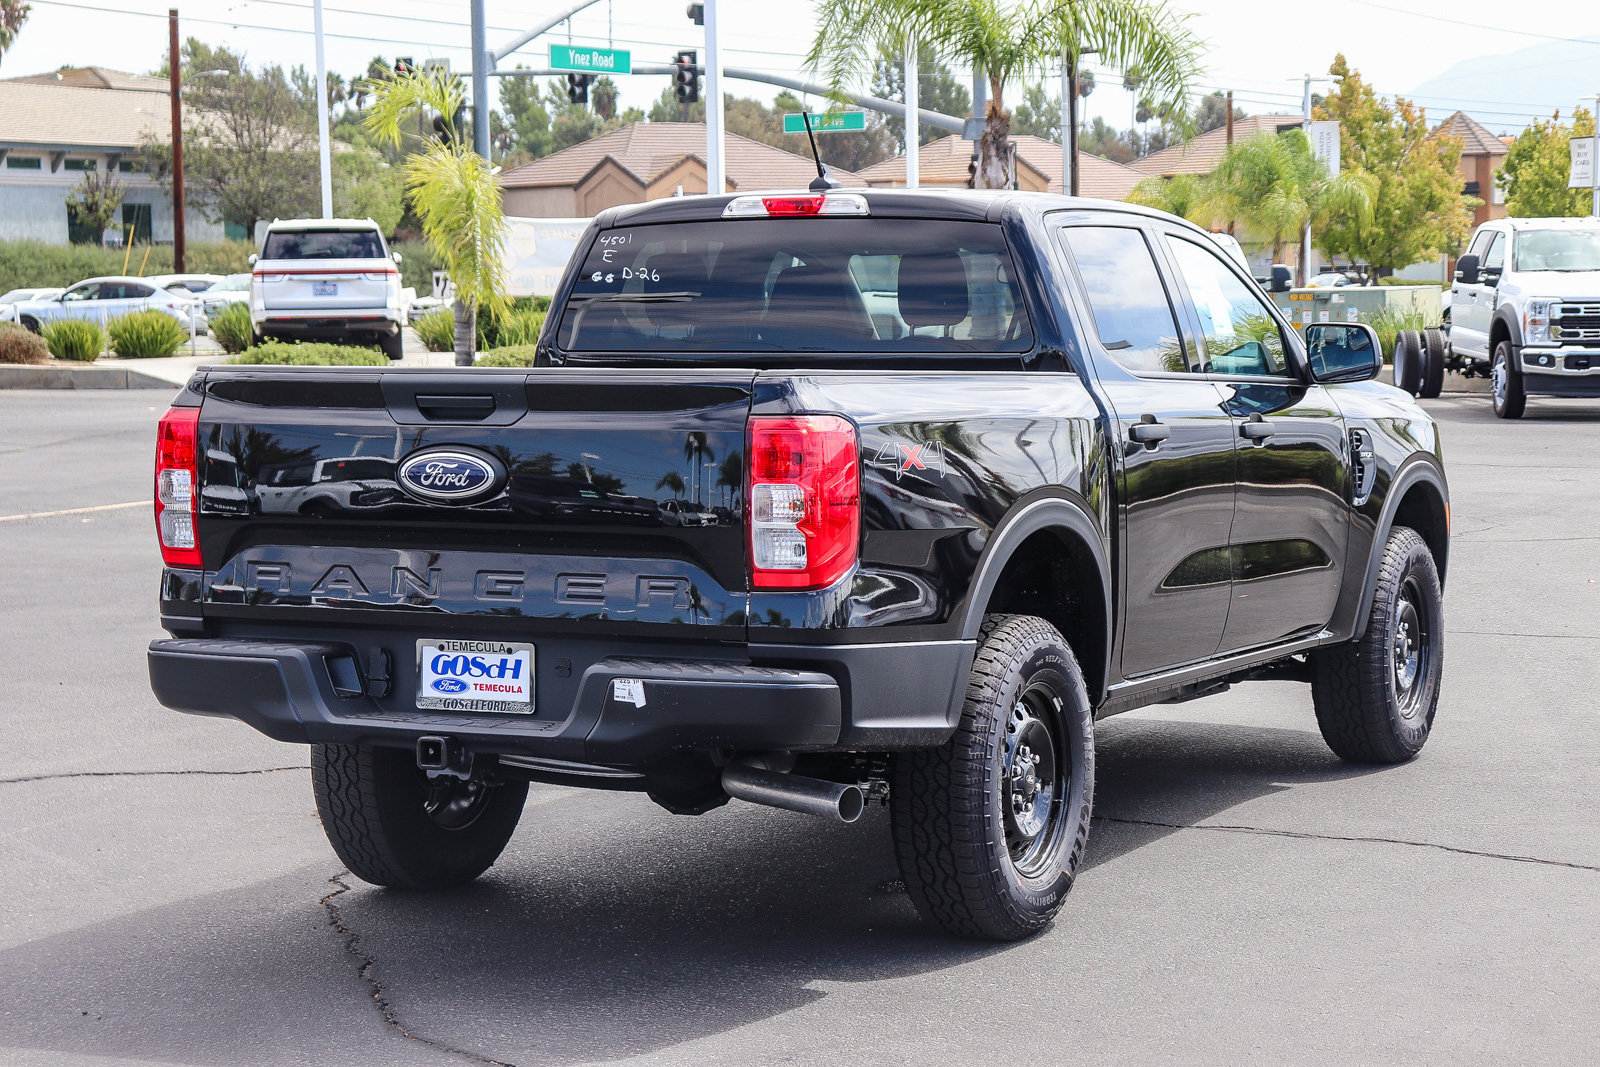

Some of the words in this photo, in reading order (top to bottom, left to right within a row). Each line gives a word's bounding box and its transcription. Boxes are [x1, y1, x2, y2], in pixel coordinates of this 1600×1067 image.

[568, 49, 590, 65] Ynez
[592, 51, 614, 67] Road
[600, 233, 632, 246] 4501
[602, 249, 618, 263] E
[622, 267, 660, 282] D-26
[420, 461, 471, 487] Ford
[246, 560, 692, 609] RANGER
[444, 640, 506, 653] TEMECULA
[438, 679, 461, 692] Ford
[473, 682, 523, 694] TEMECULA
[481, 700, 507, 712] FORD
[1068, 715, 1093, 872] WRANGLER
